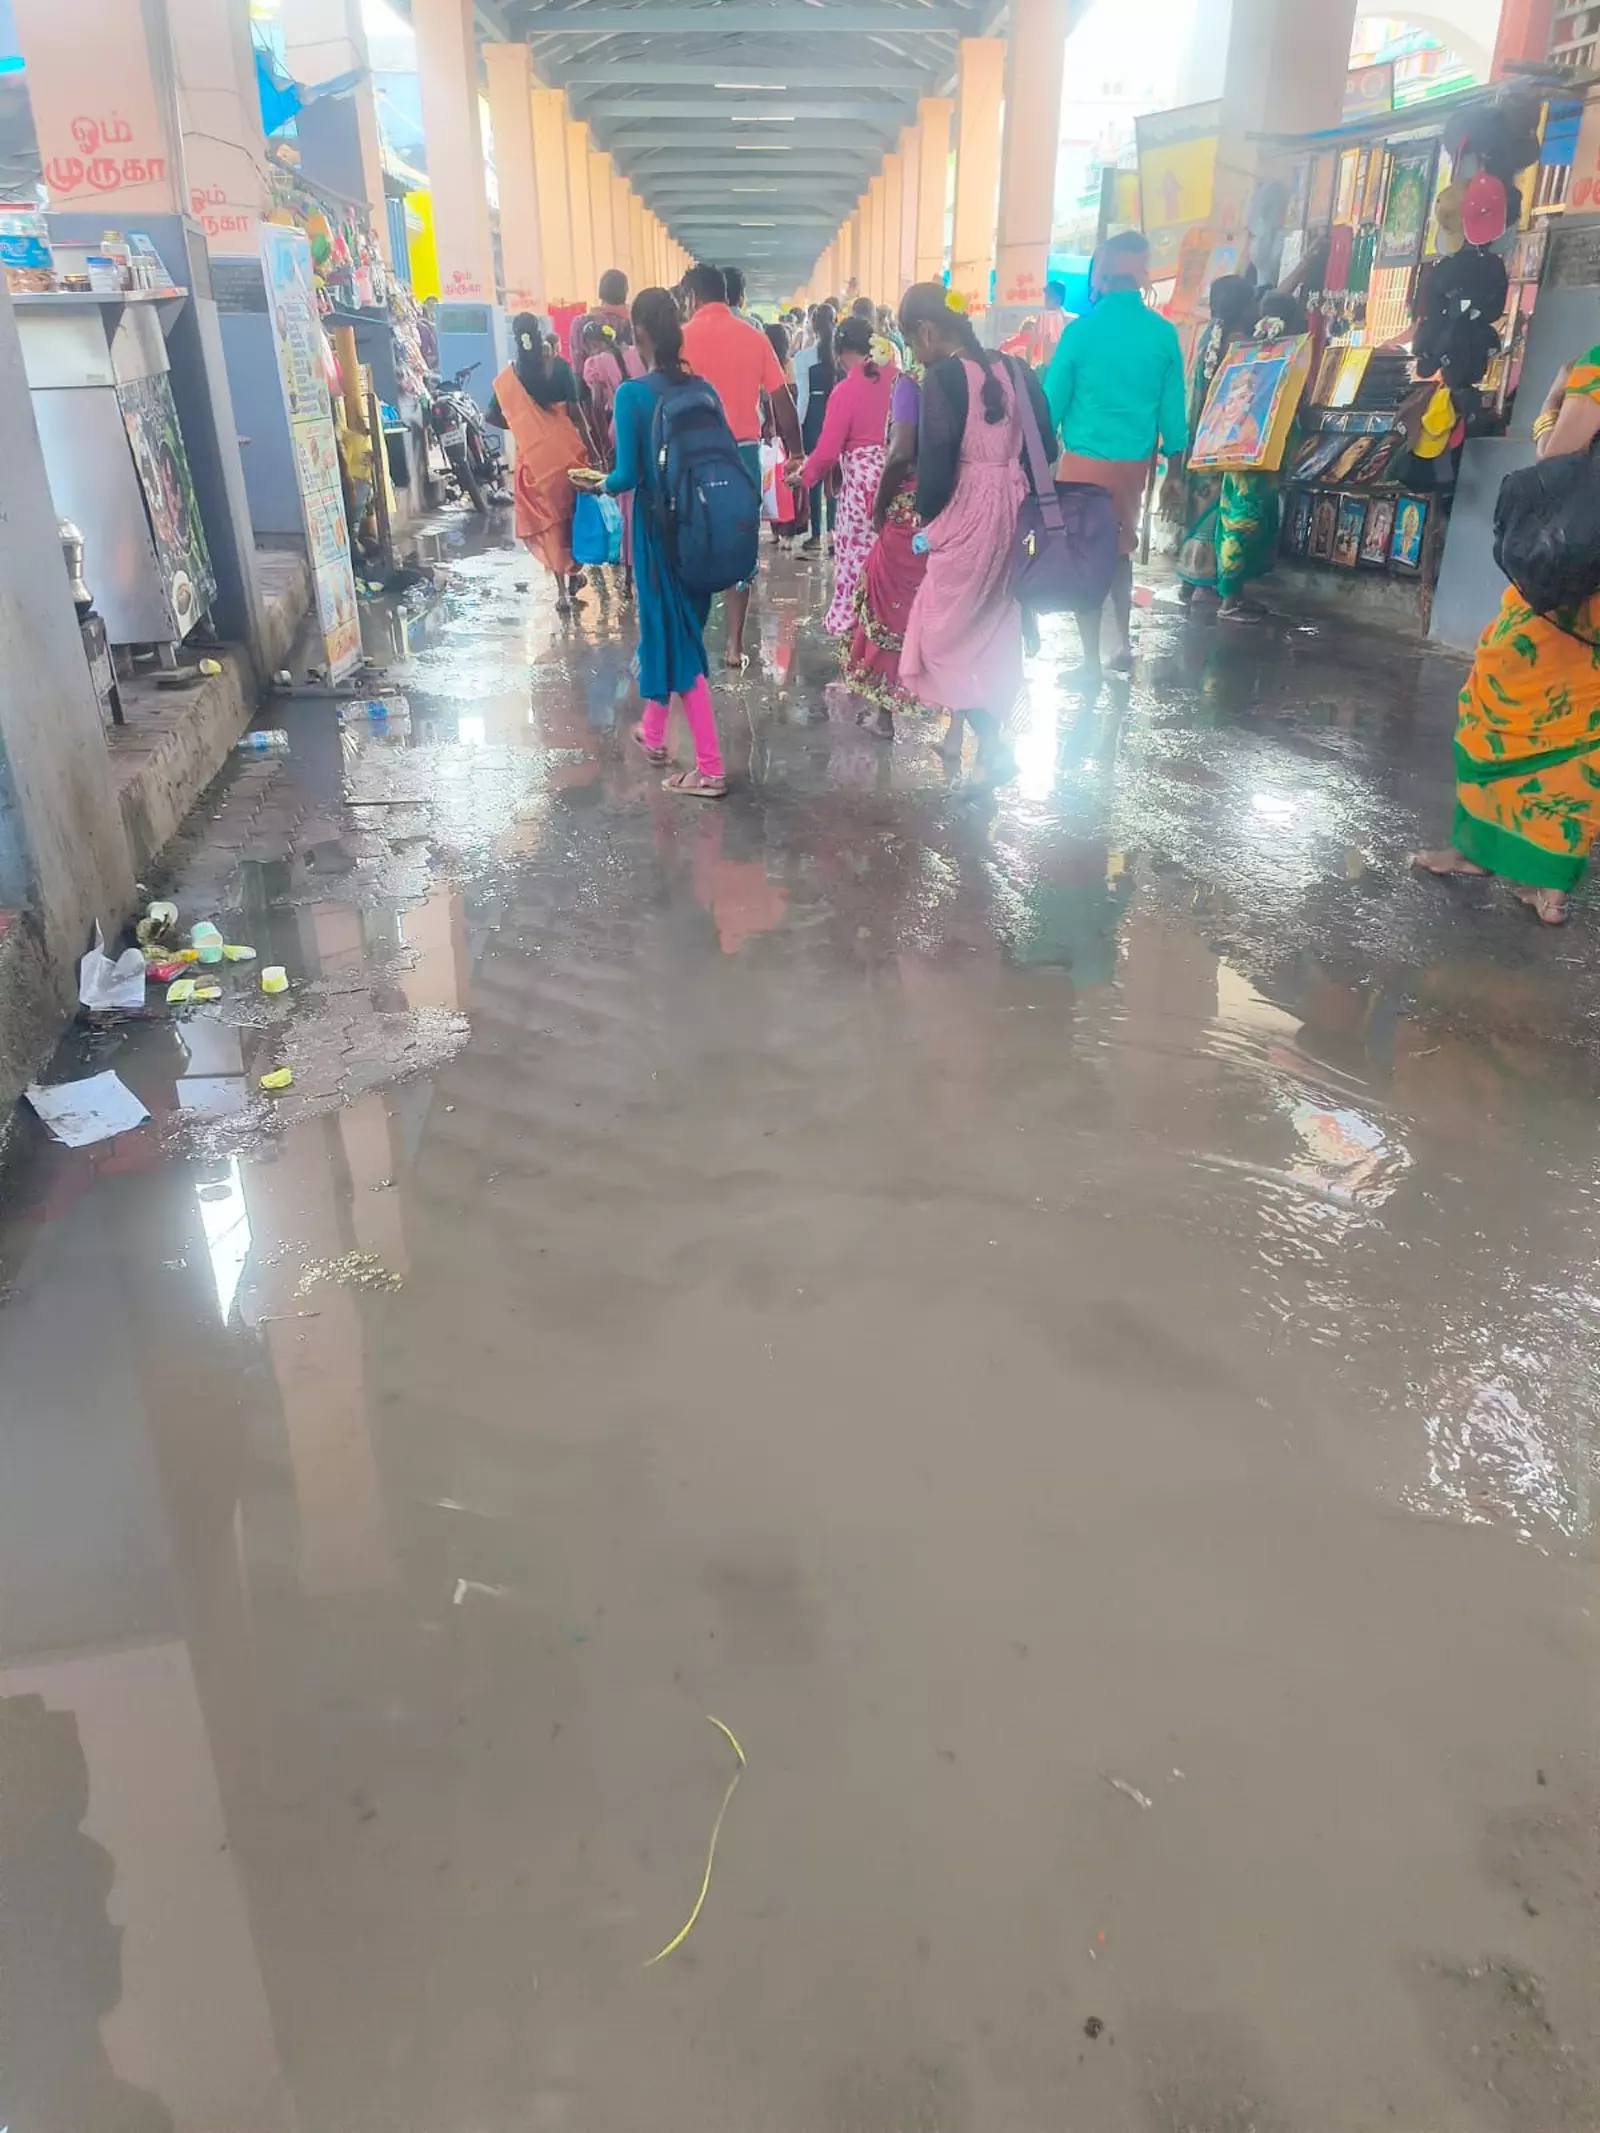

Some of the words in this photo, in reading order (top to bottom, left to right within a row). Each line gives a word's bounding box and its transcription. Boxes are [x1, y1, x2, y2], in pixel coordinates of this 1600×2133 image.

[71, 110, 133, 155] ஓம்
[44, 157, 164, 193] முருகா
[201, 215, 249, 236] ருகா
